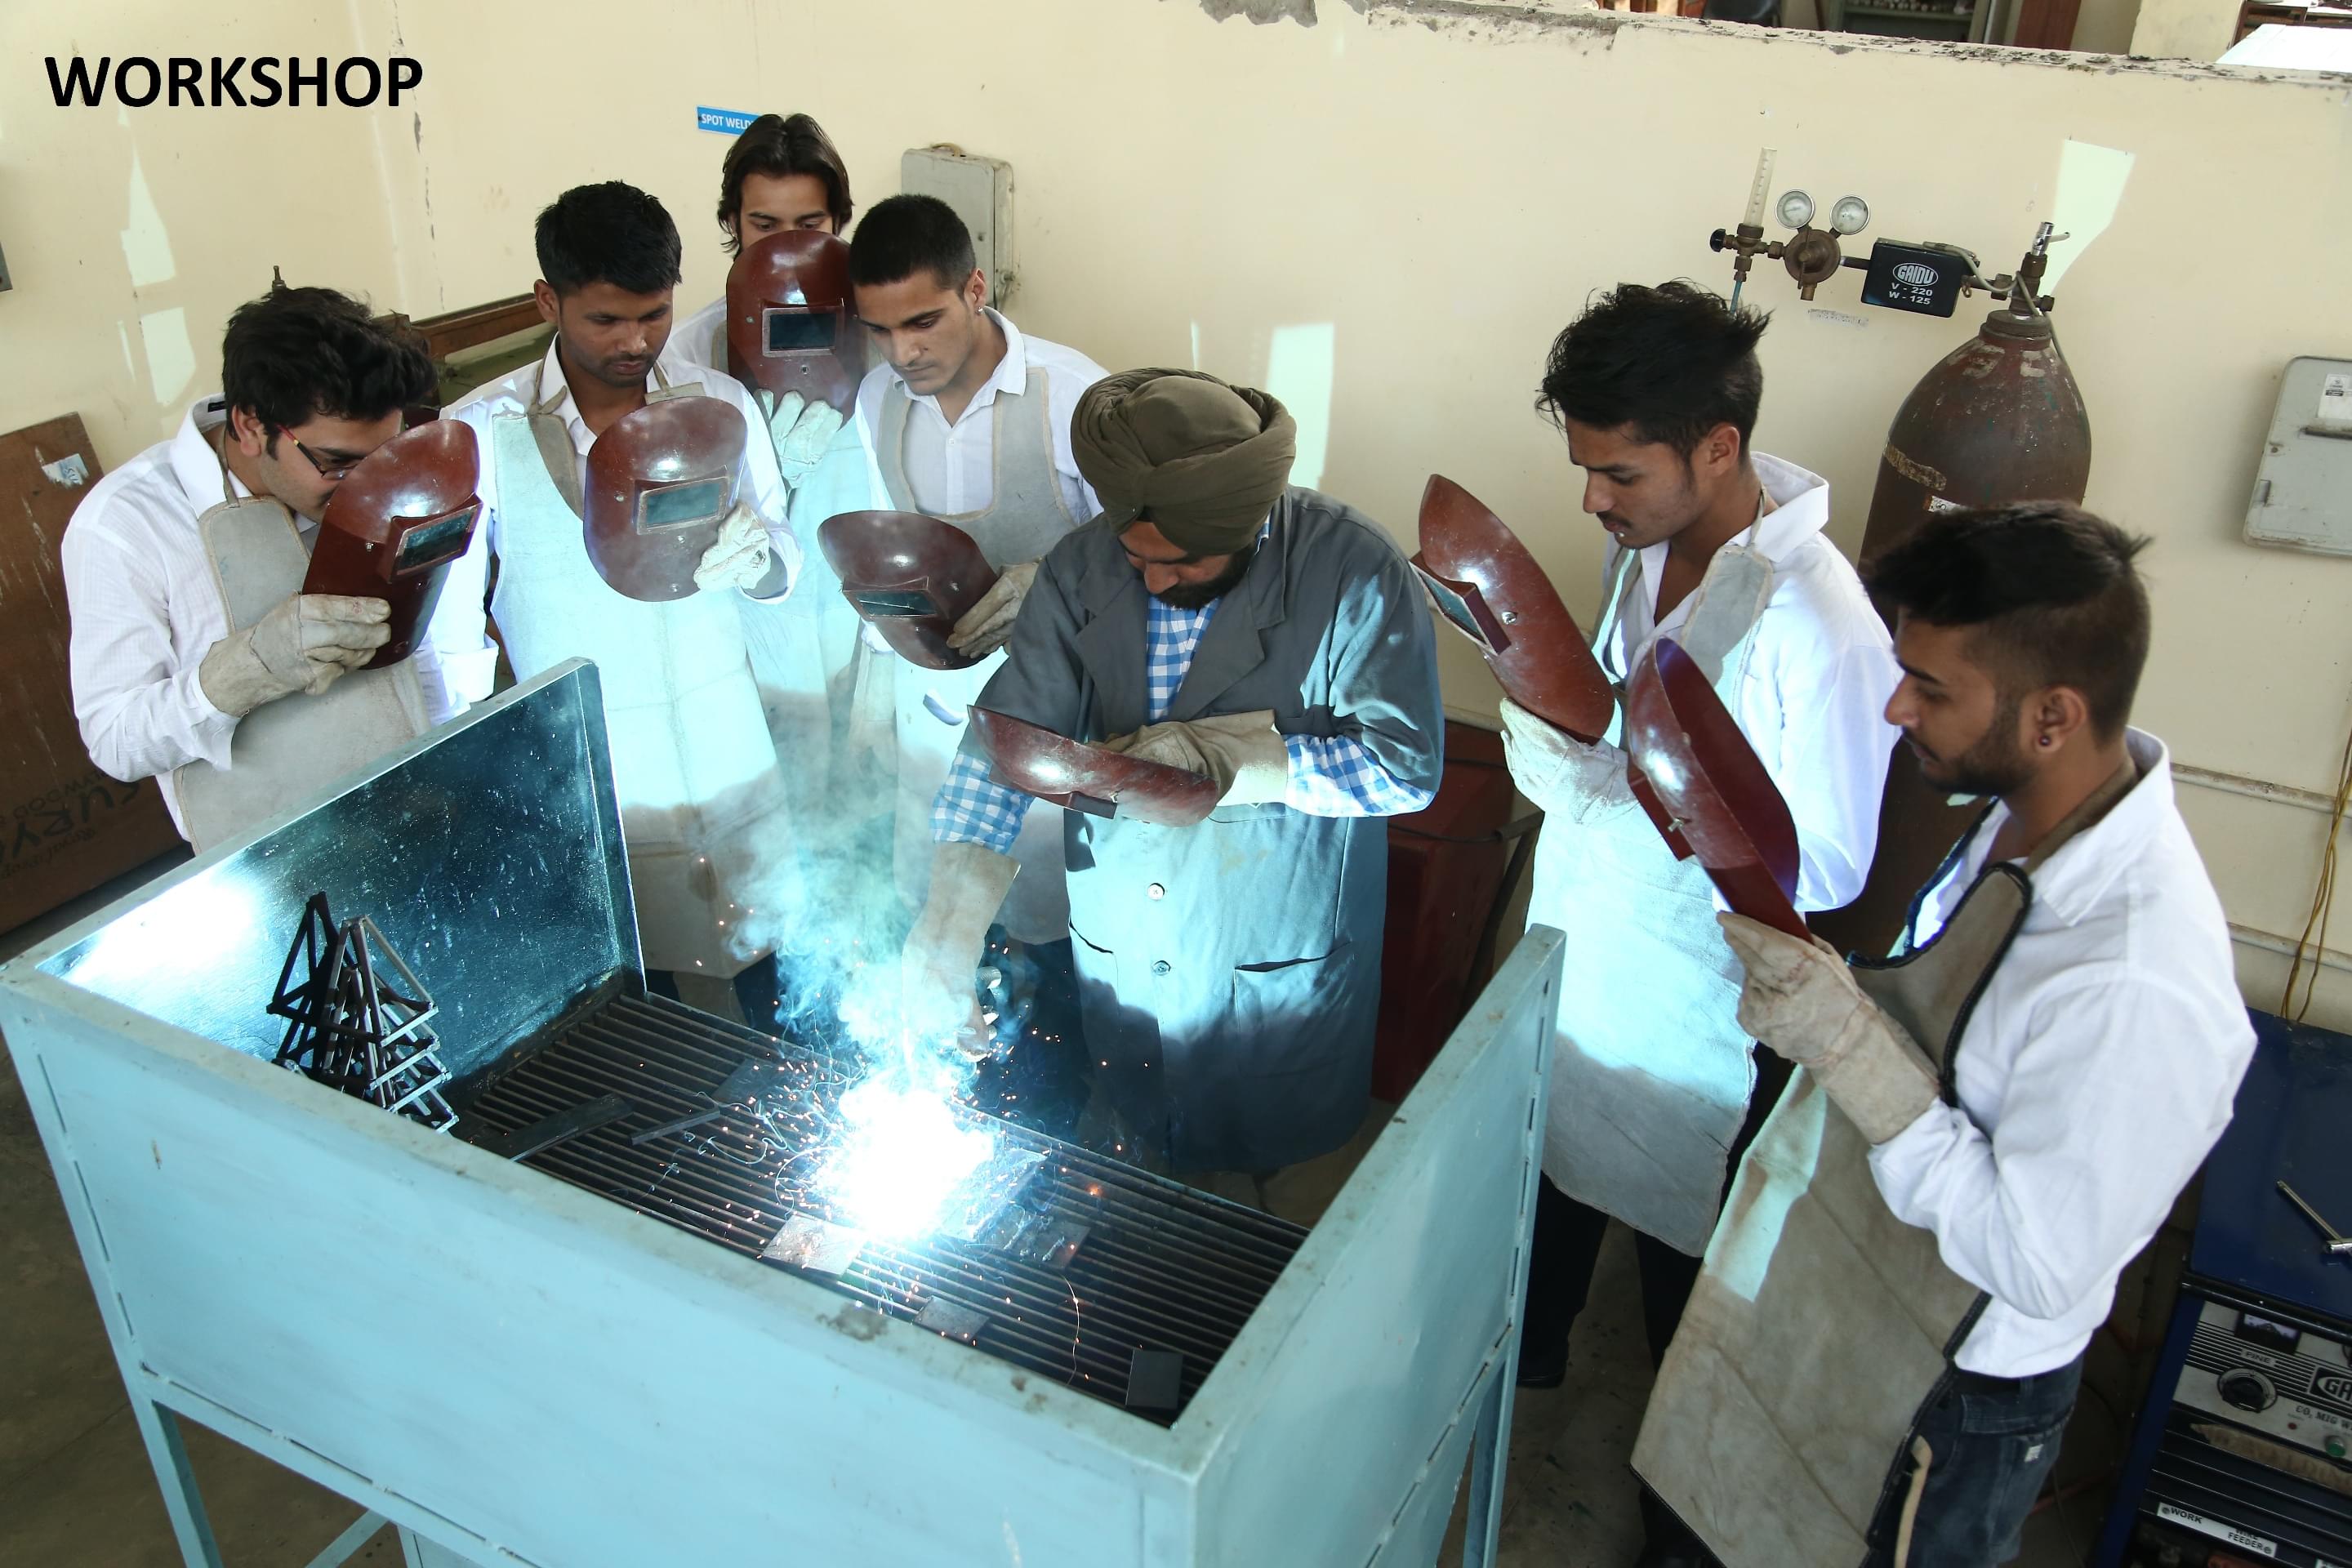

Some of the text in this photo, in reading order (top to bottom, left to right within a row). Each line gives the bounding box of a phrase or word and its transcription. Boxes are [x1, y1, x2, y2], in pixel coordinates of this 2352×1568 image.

[702, 114, 754, 130] SPOT WELD
[1897, 265, 1934, 284] GAIDU
[1889, 291, 1900, 299] W
[1909, 295, 1931, 305] 125
[1911, 287, 1933, 296] 220
[2325, 1378, 2352, 1401] GA
[2171, 1508, 2203, 1524] WORK
[2228, 1532, 2263, 1550] FEEDER
